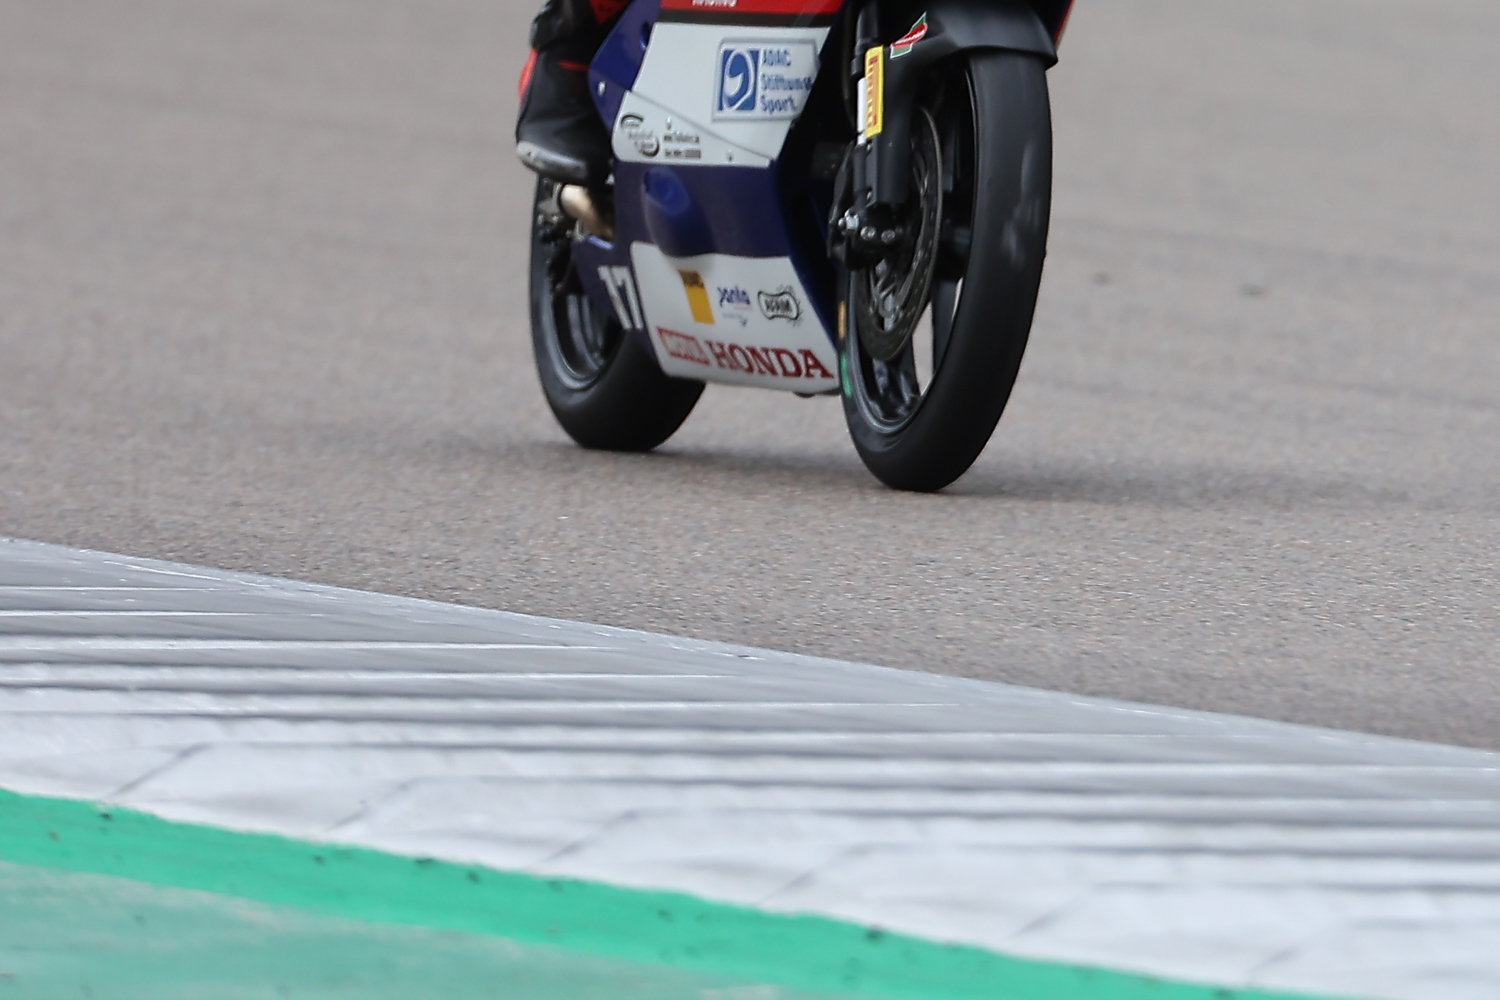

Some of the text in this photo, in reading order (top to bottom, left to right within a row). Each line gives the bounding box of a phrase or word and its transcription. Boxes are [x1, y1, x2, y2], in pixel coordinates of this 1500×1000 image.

[762, 49, 791, 67] ADAC
[761, 95, 797, 114] Sport
[598, 265, 643, 331] 17
[704, 340, 834, 379] HONDA
